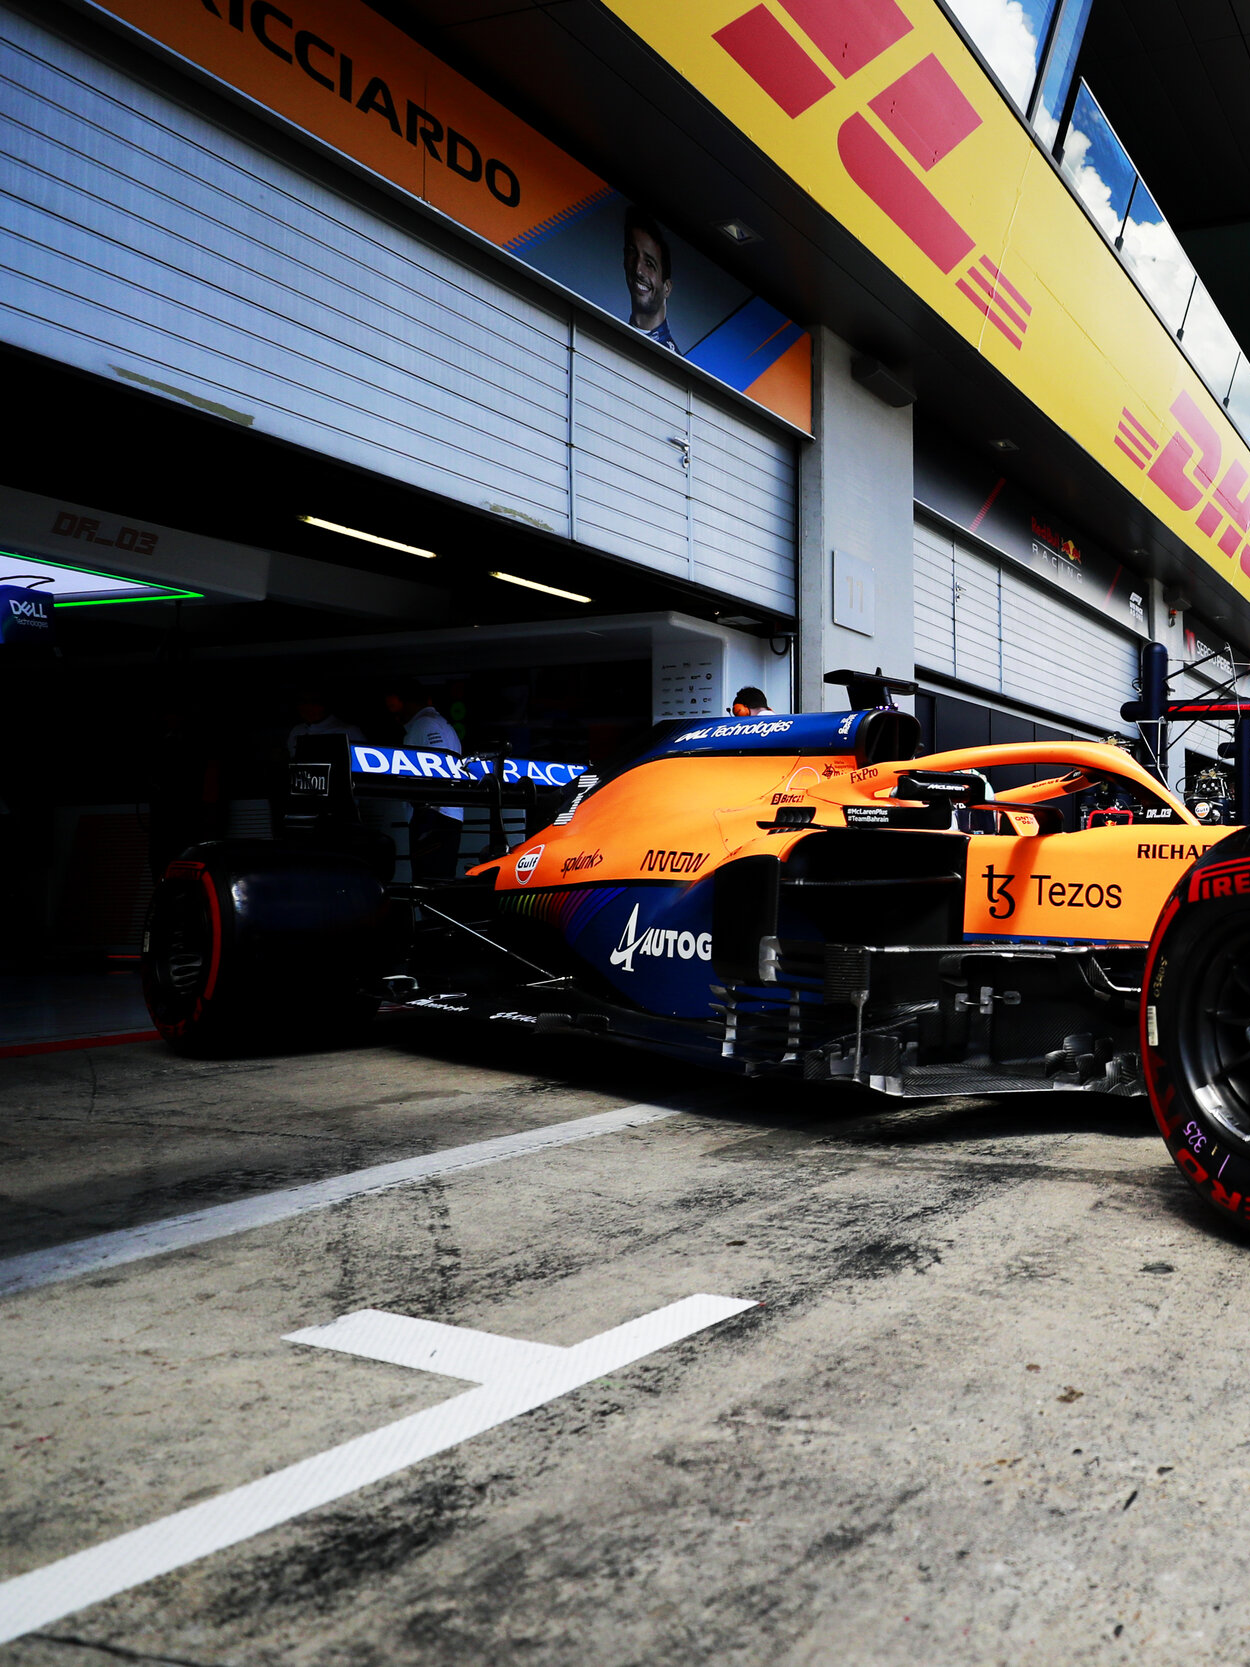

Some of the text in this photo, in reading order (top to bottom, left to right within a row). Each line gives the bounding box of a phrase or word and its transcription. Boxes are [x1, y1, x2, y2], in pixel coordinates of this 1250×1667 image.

[203, 0, 521, 208] ICCIARDO
[845, 575, 864, 614] 11
[9, 599, 48, 619] DELL
[710, 719, 794, 738] Technologies
[849, 767, 879, 784] FxPro
[927, 784, 966, 792] McLaren
[847, 808, 889, 816] #McLarenPlus
[848, 815, 890, 823] #TeamBahrain
[517, 856, 540, 869] Gulf
[1030, 874, 1122, 909] Tezos
[1182, 1120, 1208, 1154] 325
